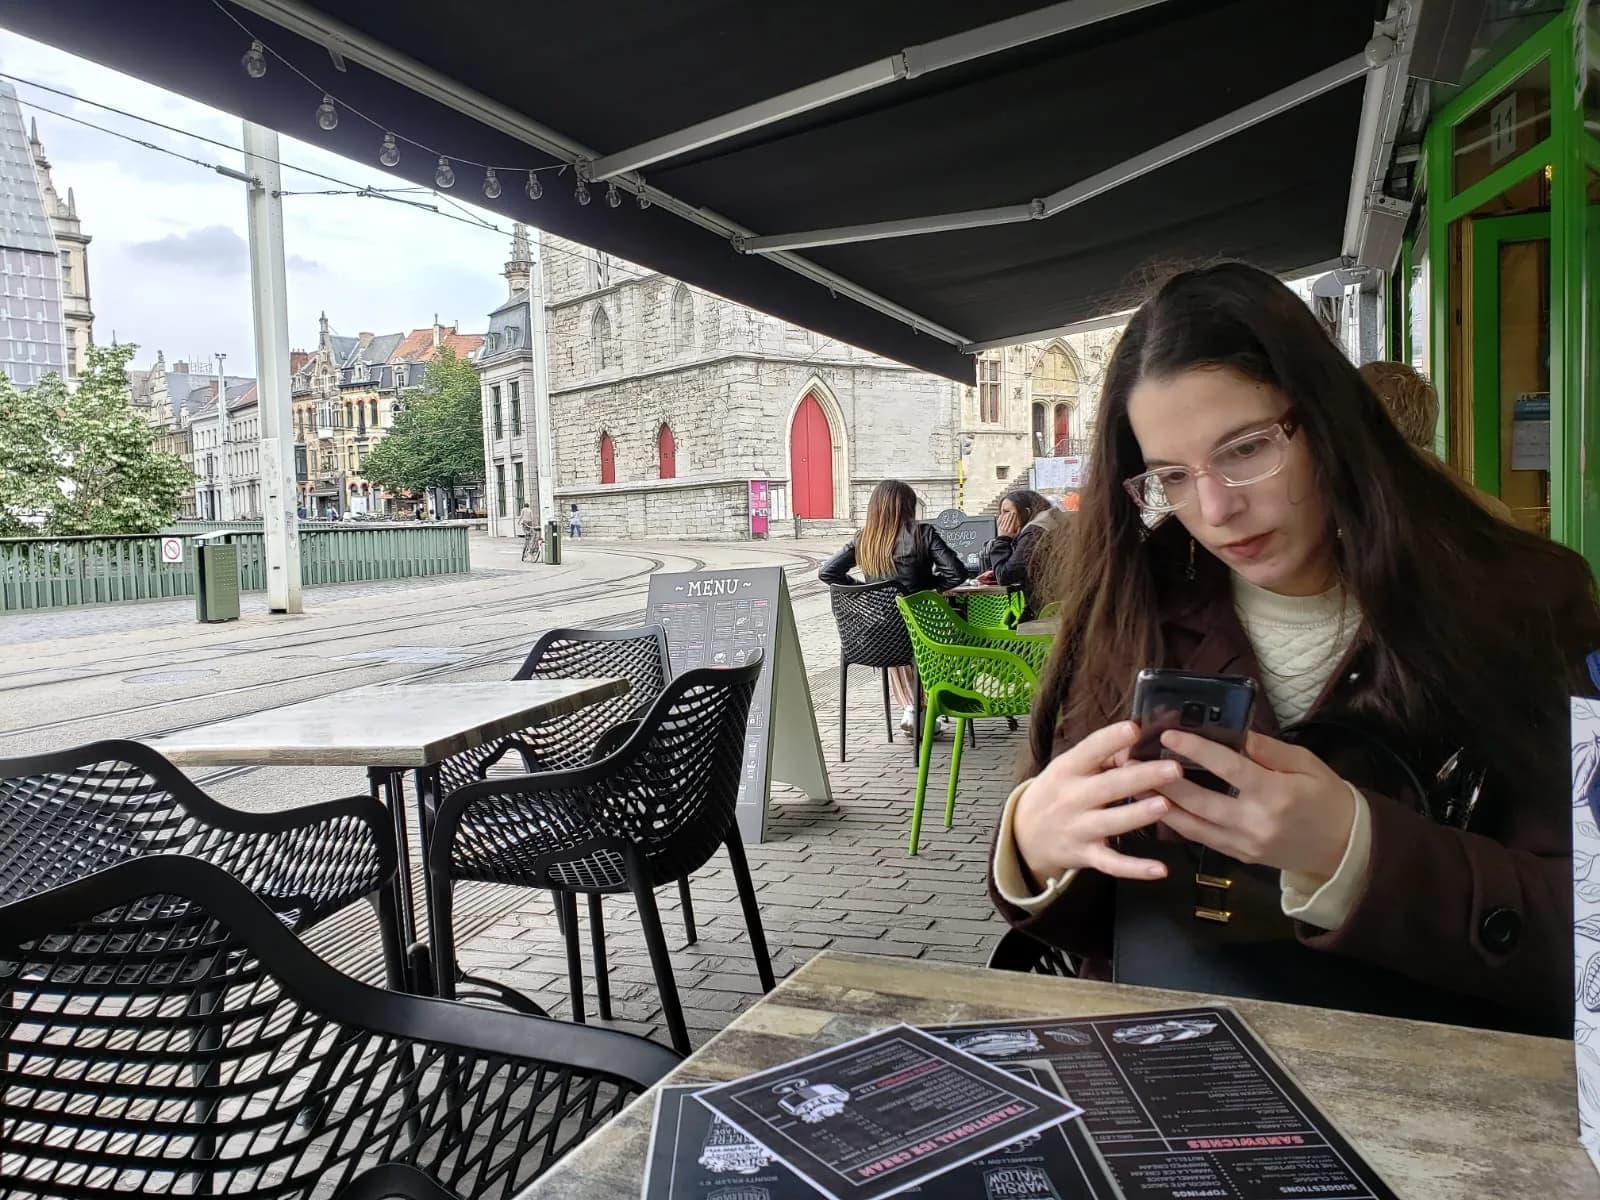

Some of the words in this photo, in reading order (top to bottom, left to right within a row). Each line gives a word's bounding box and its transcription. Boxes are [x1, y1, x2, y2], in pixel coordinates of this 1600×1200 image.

[687, 579, 740, 597] MENU
[935, 1104, 1026, 1144] TRADITIONAL
[910, 1140, 938, 1155] ICE
[1186, 1135, 1304, 1149] SANDWICHES
[858, 1151, 912, 1176] CREAM
[989, 1170, 1044, 1186] MALLOW
[992, 1180, 1049, 1194] MARSH-
[1172, 1189, 1228, 1198] TOPPINGS
[1280, 1184, 1358, 1193] SUGGESTIONS
